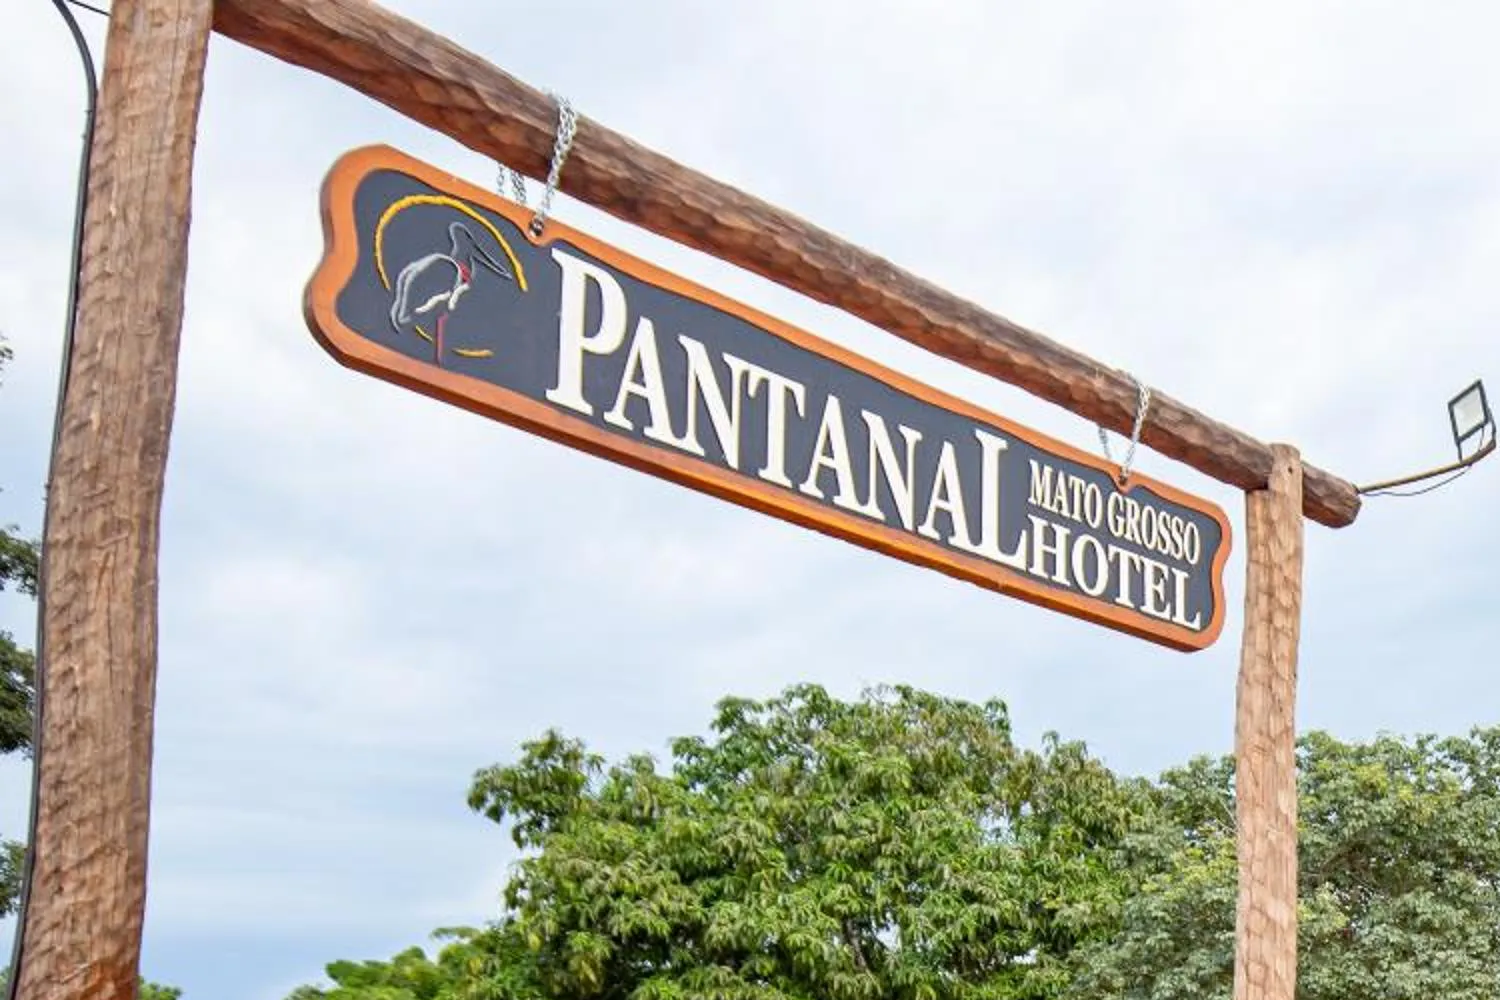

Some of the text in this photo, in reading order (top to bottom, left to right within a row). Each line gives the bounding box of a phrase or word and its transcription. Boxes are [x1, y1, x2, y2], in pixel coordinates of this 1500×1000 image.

[545, 247, 1027, 572] PANTANAL
[1028, 459, 1200, 565] MATO GROSSO
[1027, 514, 1201, 630] HOTEL
